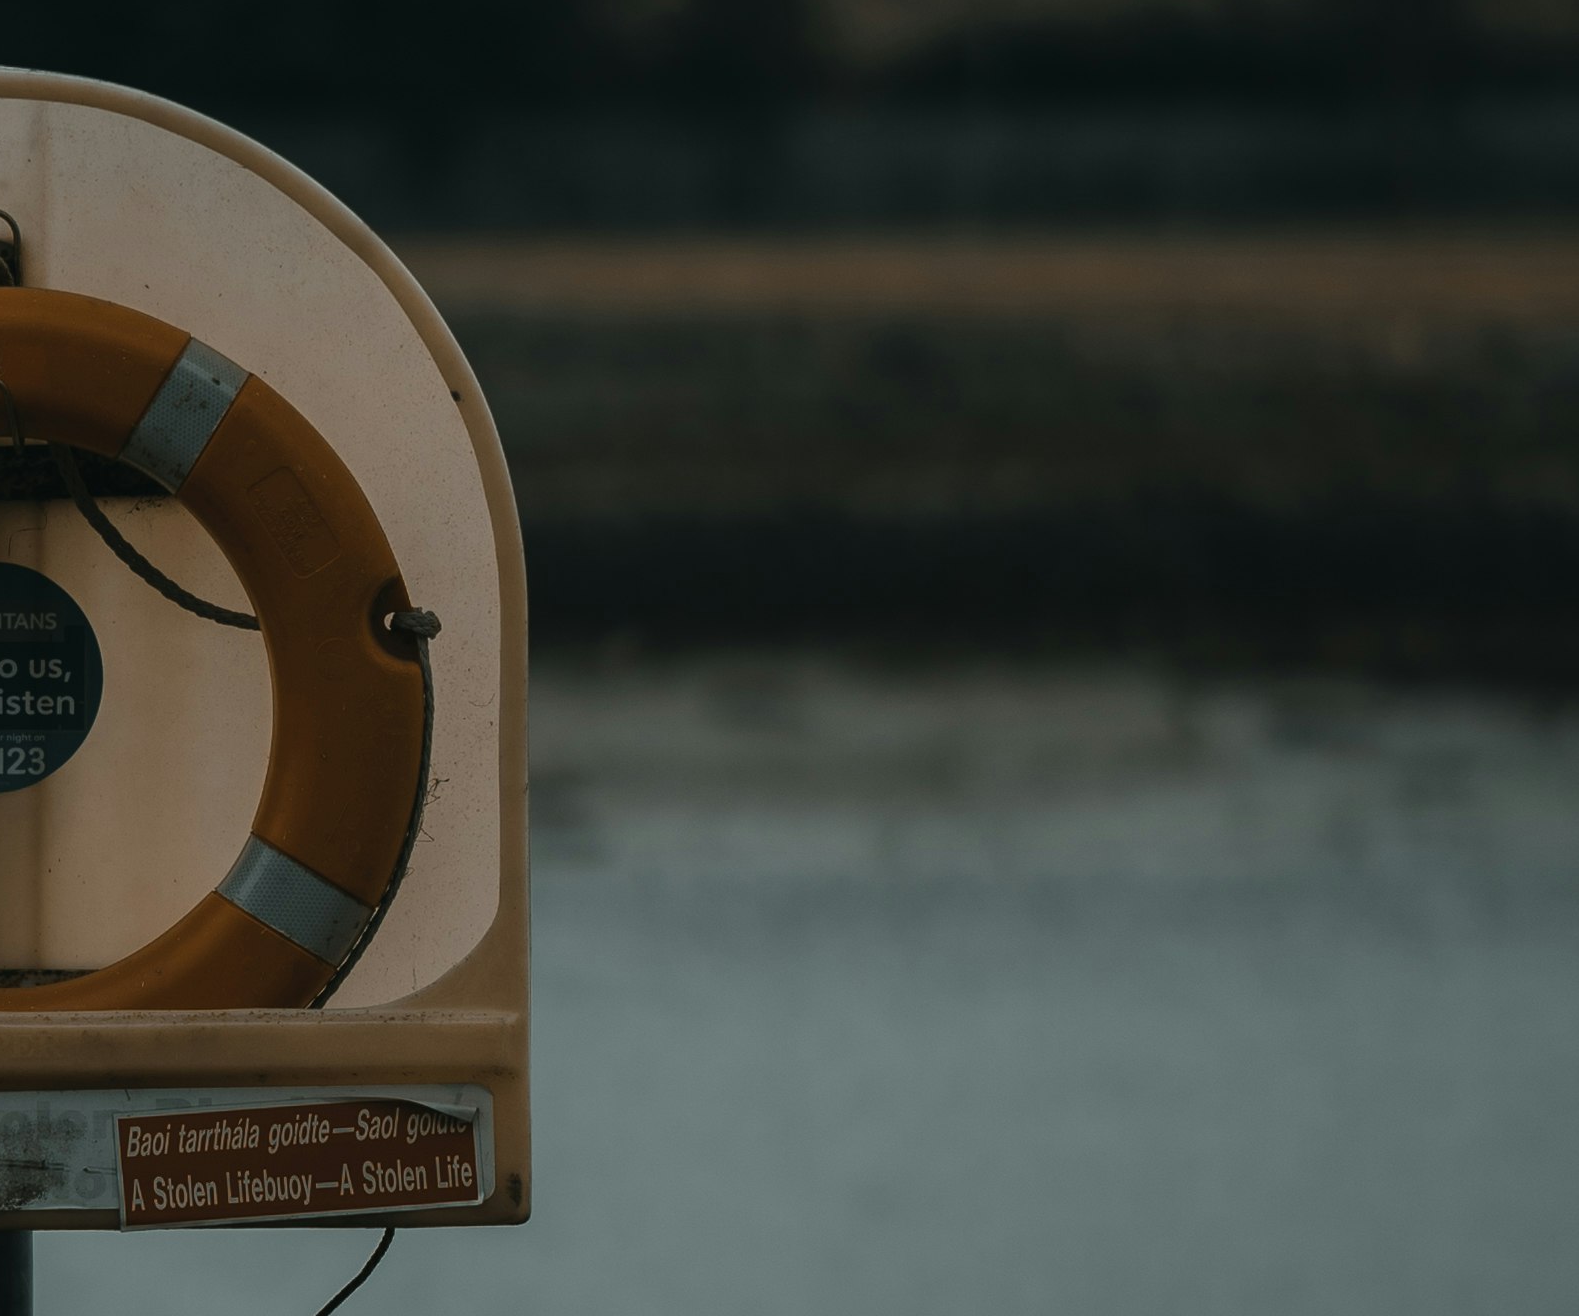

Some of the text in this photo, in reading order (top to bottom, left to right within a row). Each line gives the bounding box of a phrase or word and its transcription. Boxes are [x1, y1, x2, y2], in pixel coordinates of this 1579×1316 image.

[28, 658, 73, 683] us,
[6, 732, 33, 744] night
[34, 734, 46, 742] on
[127, 1124, 171, 1158] Baoi
[178, 1117, 261, 1154] tarrthála
[131, 1178, 146, 1212] A
[153, 1172, 219, 1211] Stolen
[362, 1158, 428, 1196] Stolen
[436, 1154, 473, 1188] Life
